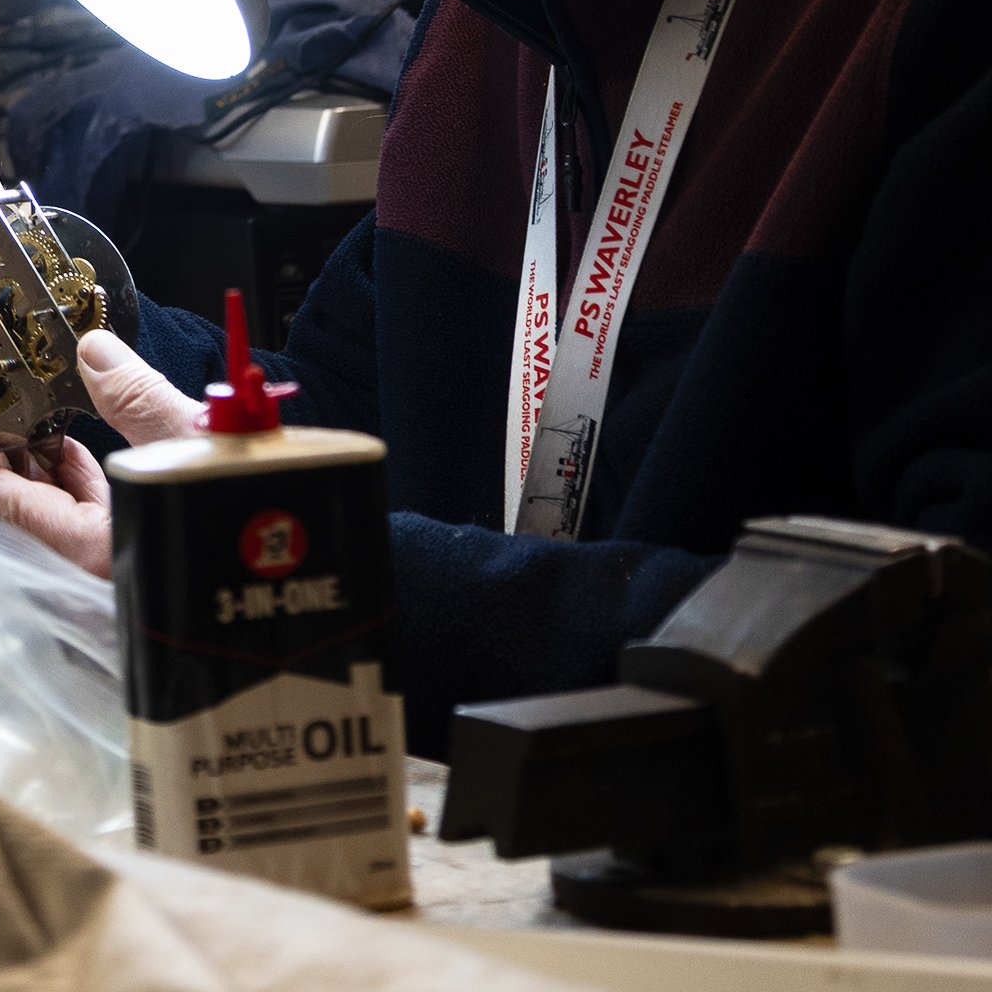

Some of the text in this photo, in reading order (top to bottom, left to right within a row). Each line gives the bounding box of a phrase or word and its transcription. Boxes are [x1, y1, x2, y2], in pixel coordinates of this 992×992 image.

[574, 128, 655, 340] PS WAVERLEY
[589, 100, 683, 381] THE WORLD'S LAST SEAGOING PADDLE STEAMER
[529, 259, 537, 283] THE
[524, 283, 535, 337] WORLD'S
[534, 292, 550, 329] PS
[522, 339, 531, 369] LAST
[521, 371, 531, 433] SEAGOING
[302, 715, 387, 762] OIL
